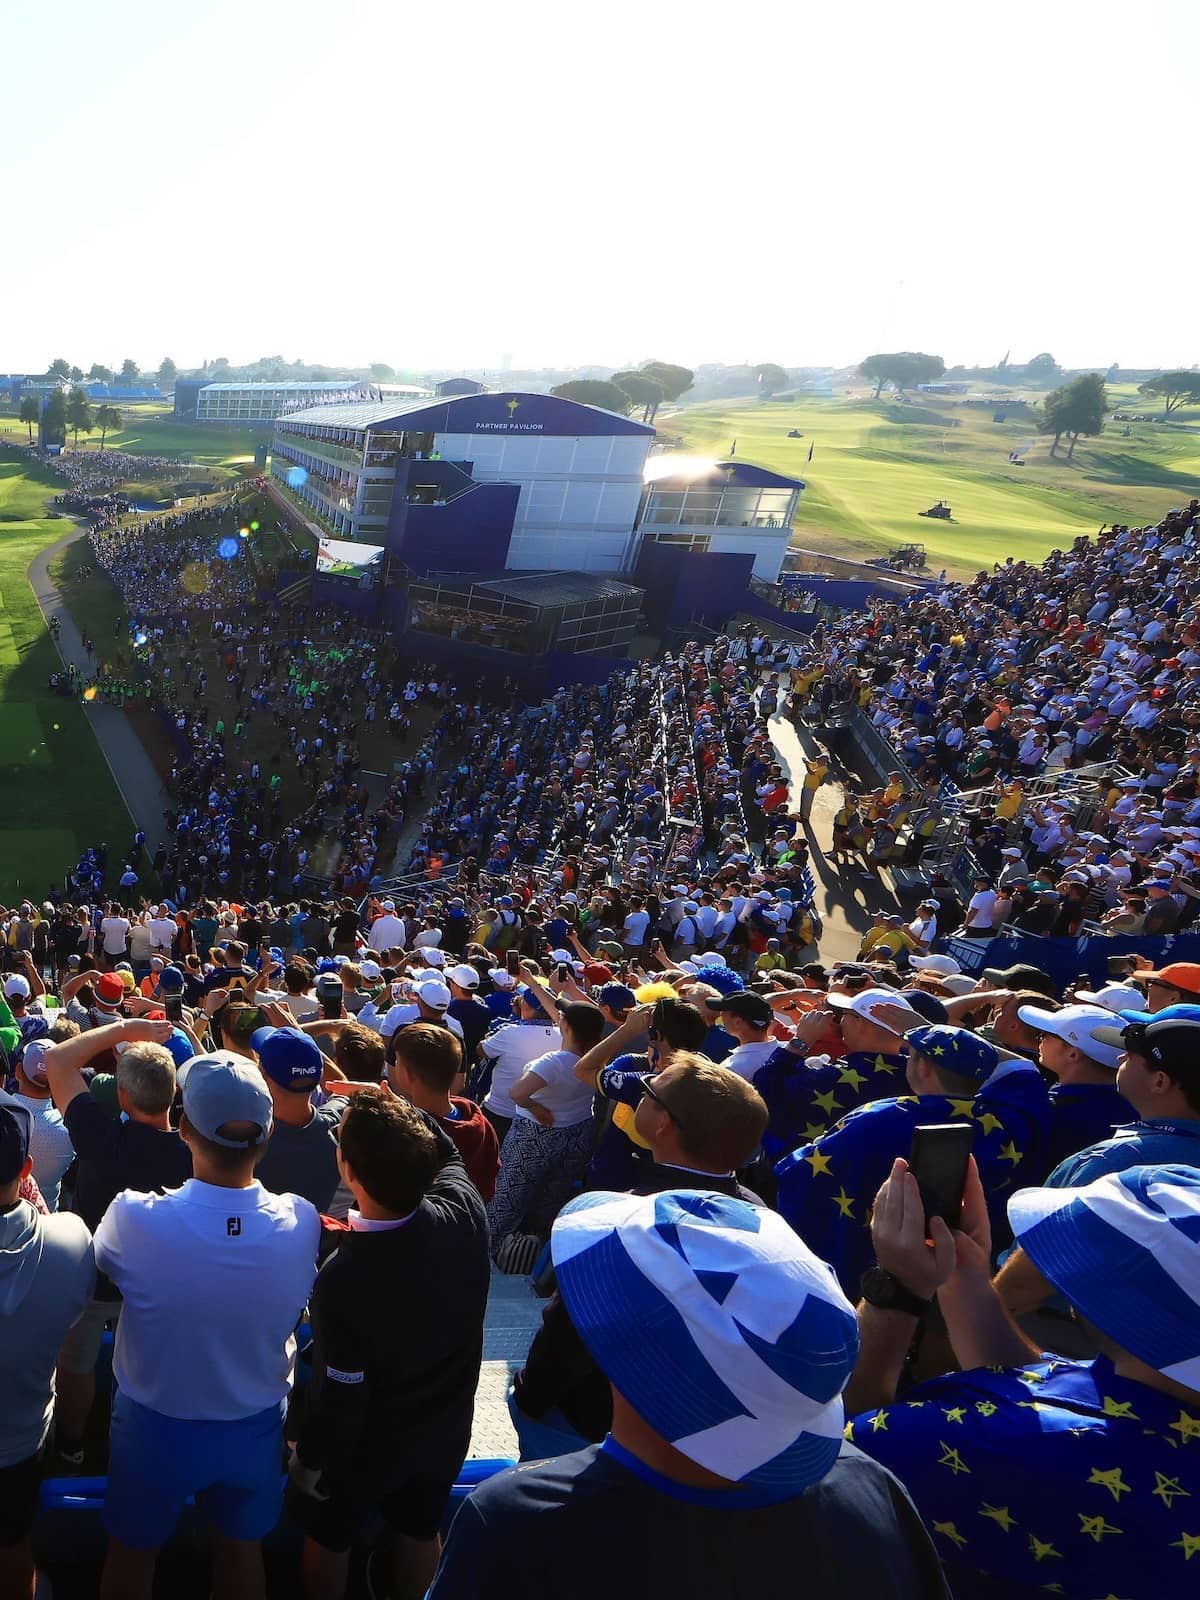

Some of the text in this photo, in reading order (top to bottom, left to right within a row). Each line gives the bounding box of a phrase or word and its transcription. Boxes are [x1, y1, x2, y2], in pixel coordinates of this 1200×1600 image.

[476, 422, 508, 430] PARTNER
[292, 1066, 316, 1075] PING
[227, 1217, 242, 1236] FJ
